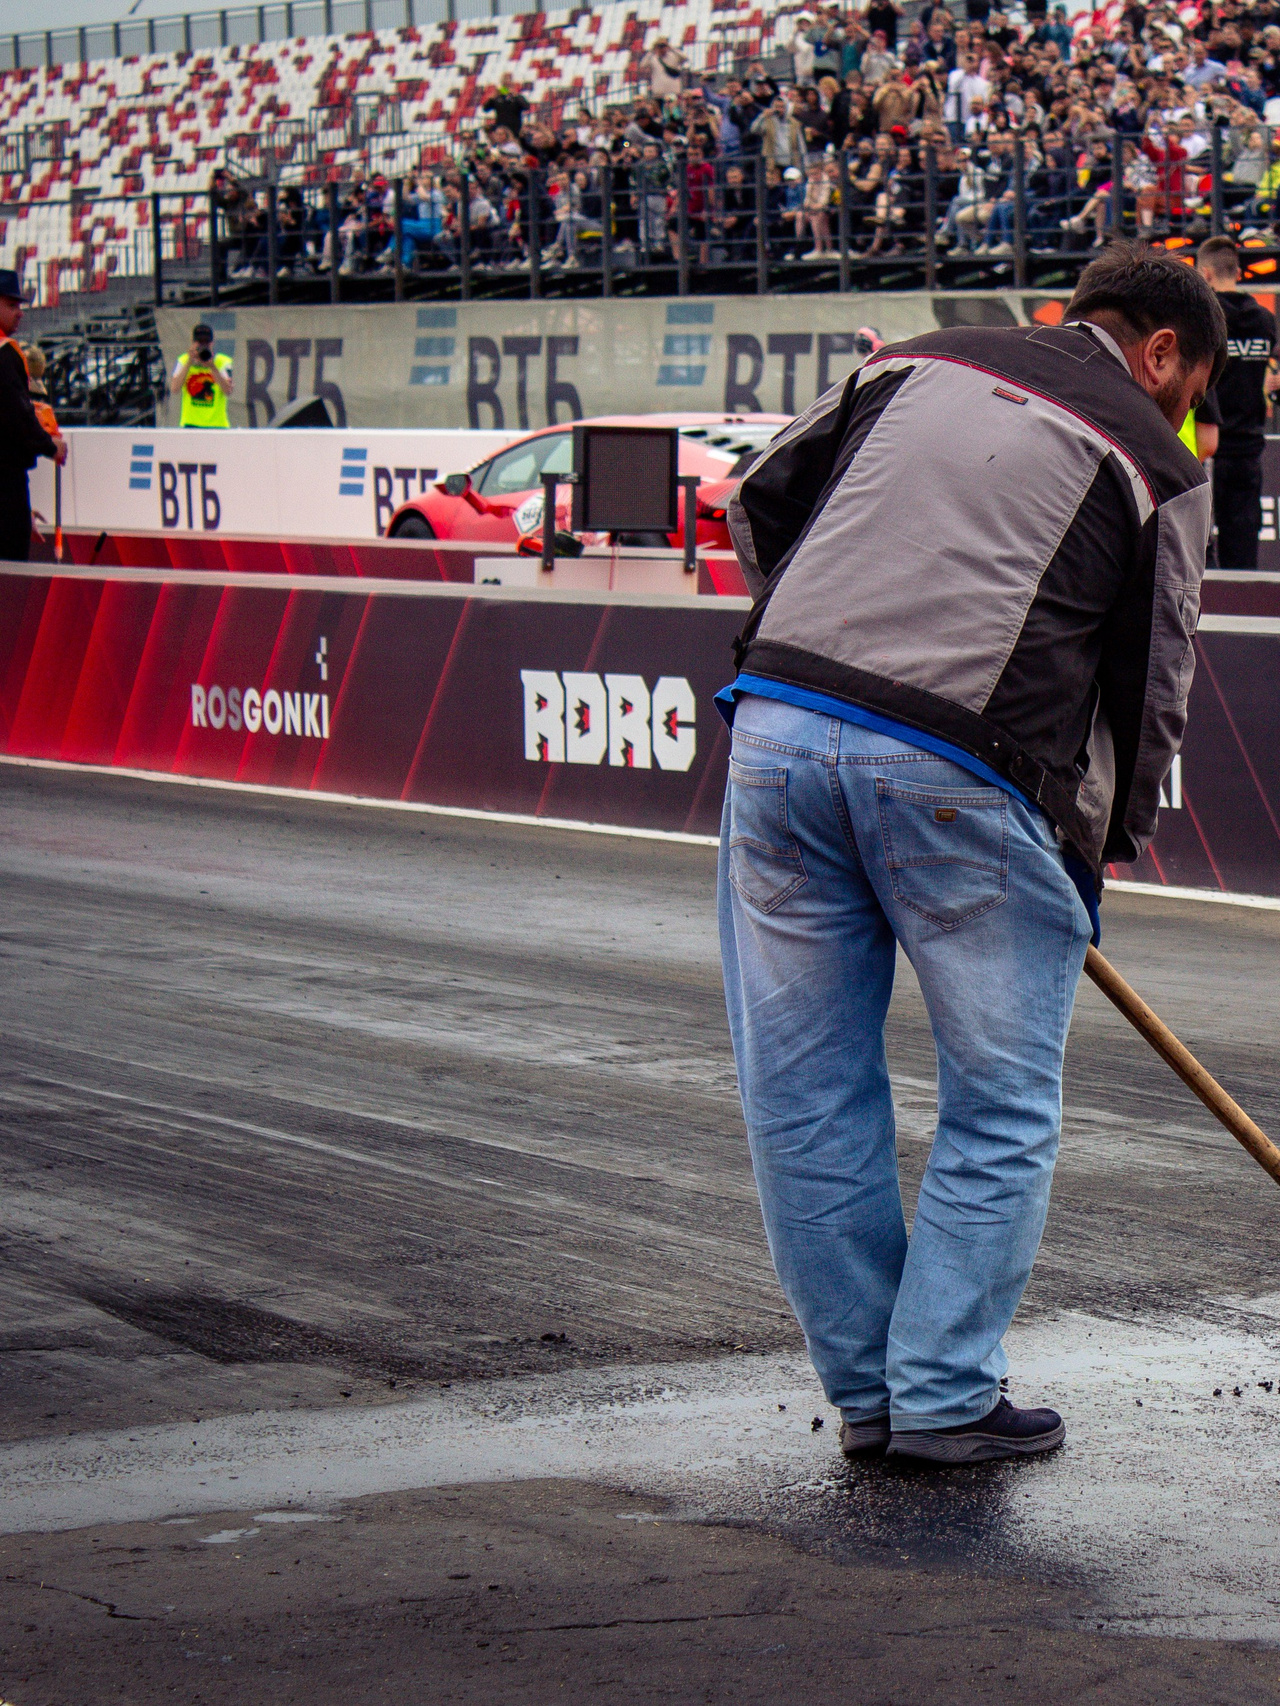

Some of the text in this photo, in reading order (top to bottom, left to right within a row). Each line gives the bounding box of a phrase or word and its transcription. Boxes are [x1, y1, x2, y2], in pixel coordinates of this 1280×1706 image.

[246, 338, 347, 428] ВТБ
[467, 336, 583, 430] ВТБ
[158, 462, 221, 530] ВТБ
[191, 683, 330, 739] ROSGONKI
[519, 668, 697, 772] RDRC
